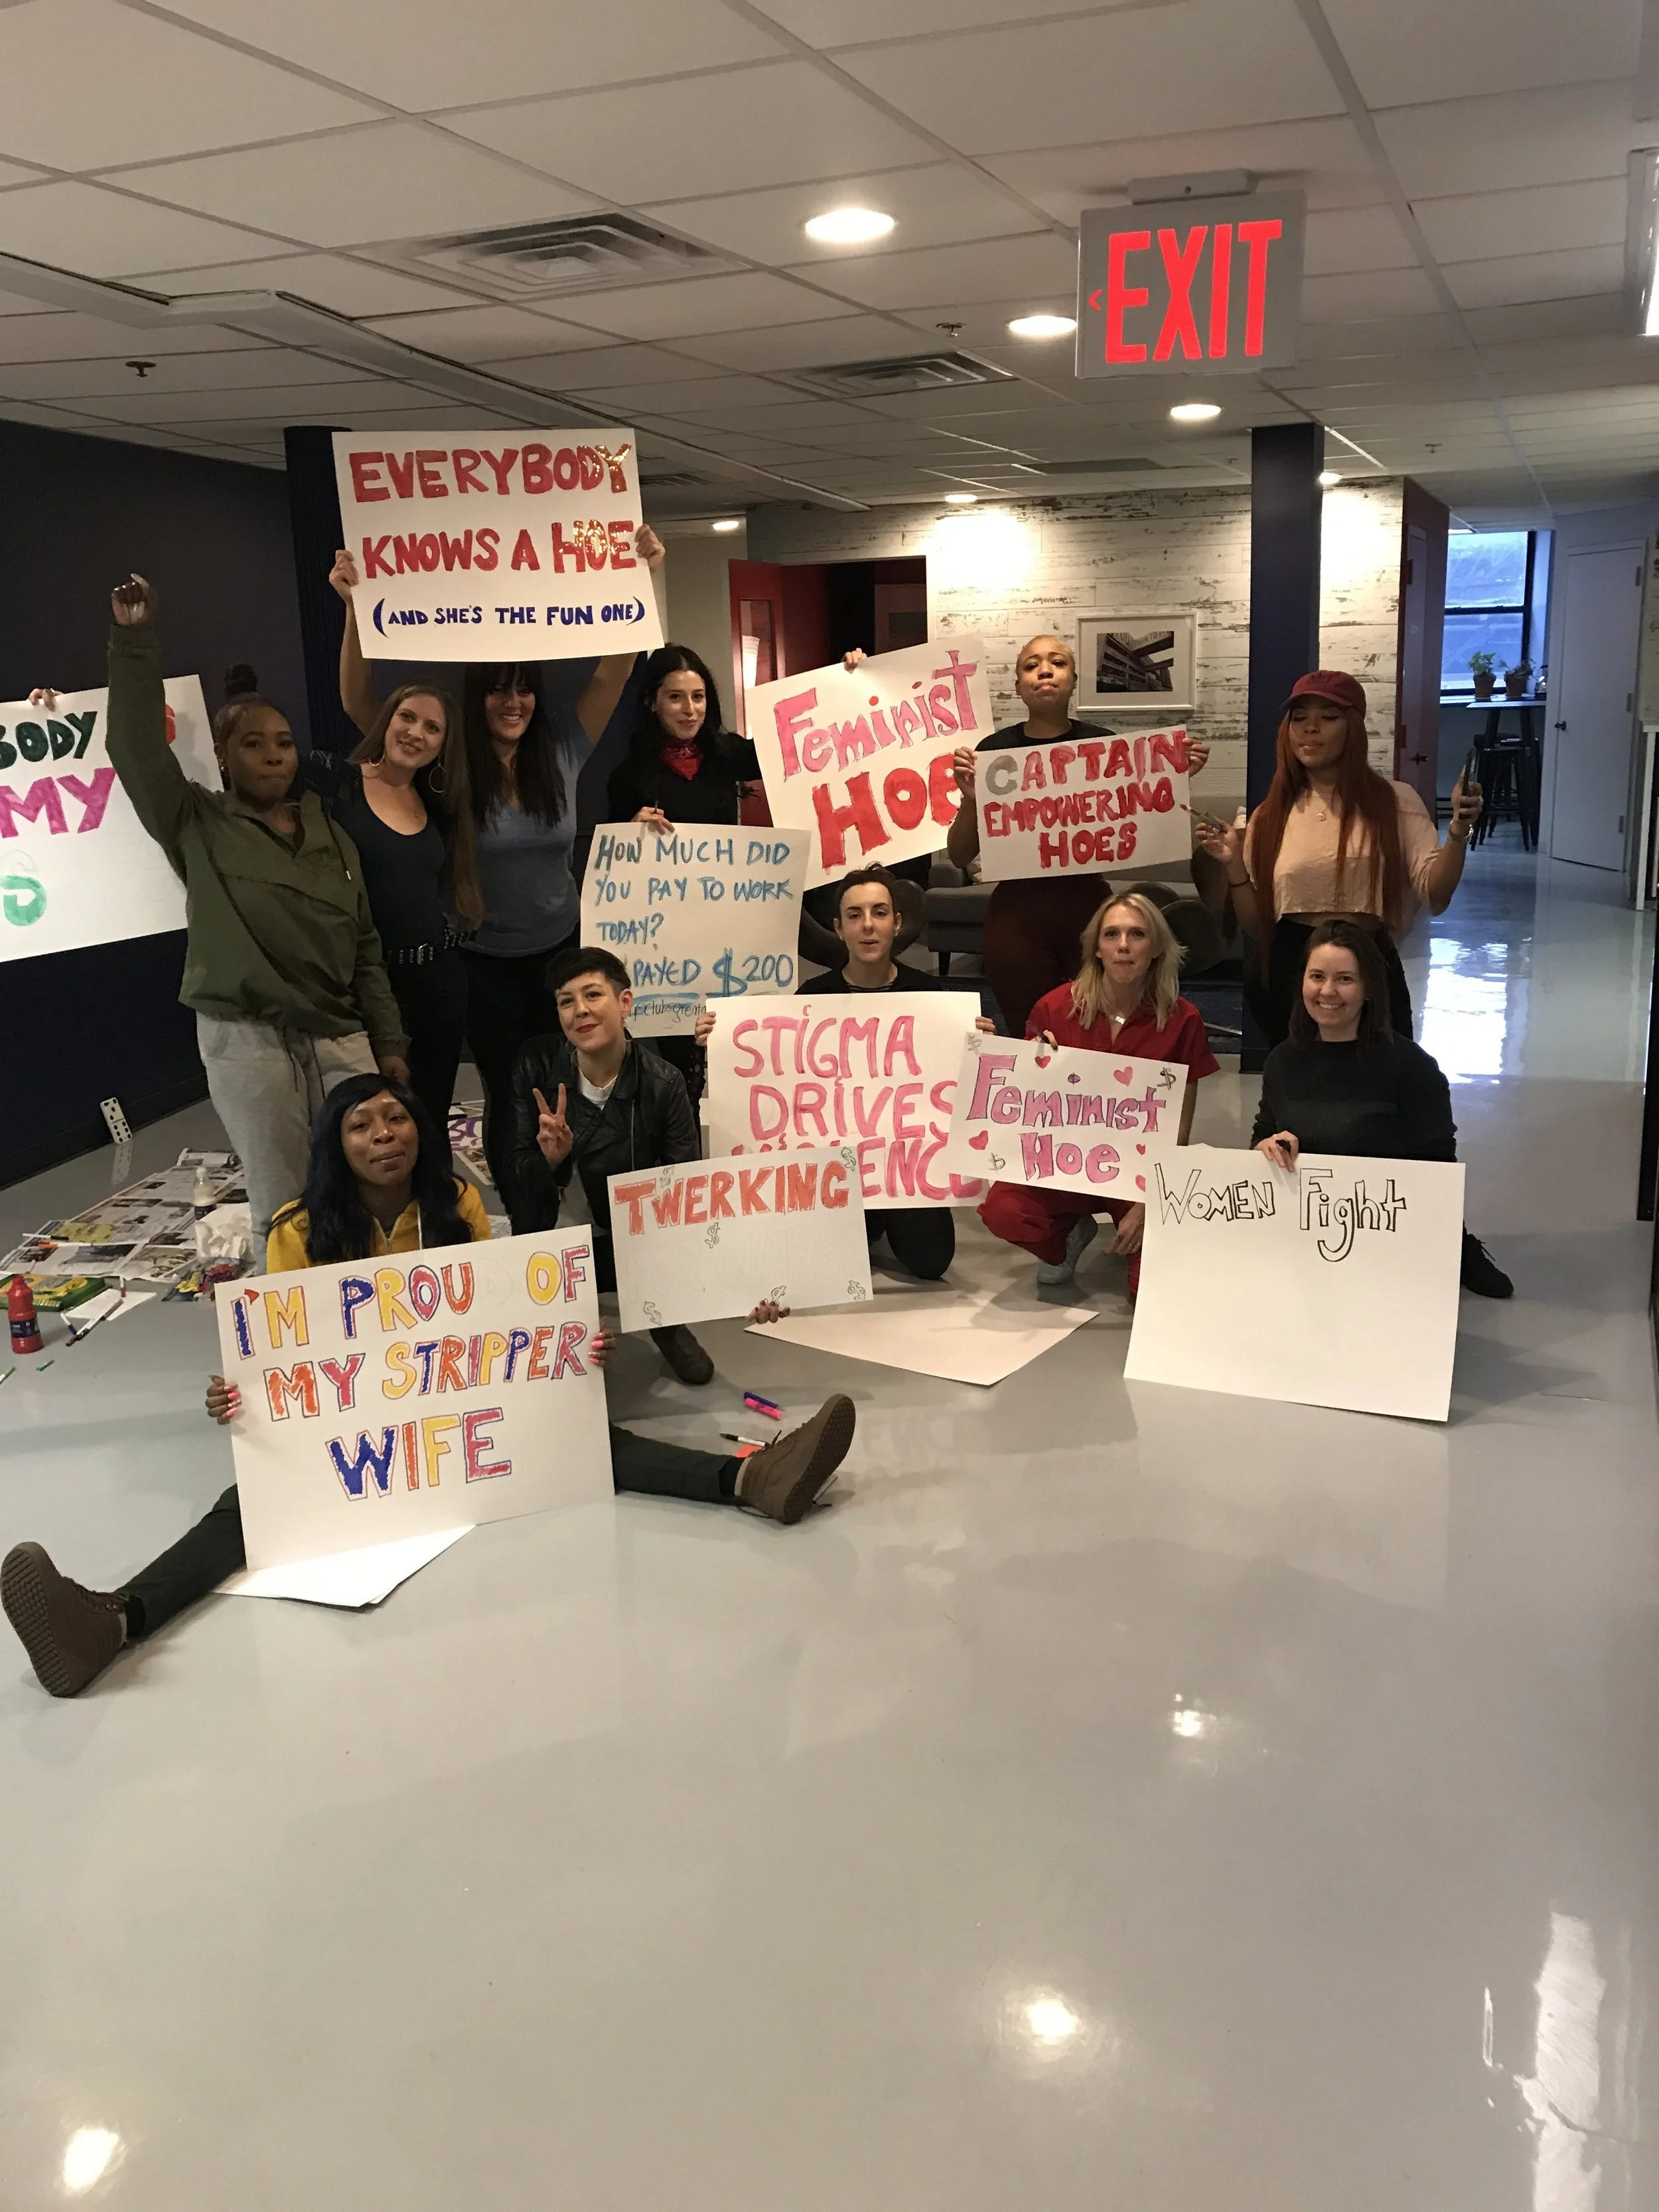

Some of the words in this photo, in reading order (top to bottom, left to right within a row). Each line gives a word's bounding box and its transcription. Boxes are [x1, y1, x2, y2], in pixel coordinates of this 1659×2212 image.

[1106, 220, 1282, 363] EXIT
[349, 443, 631, 502] EVERYBODY
[362, 528, 500, 579] KNOWS
[512, 529, 540, 571] A
[551, 519, 637, 573] HOE
[373, 598, 428, 638] (AND
[434, 605, 482, 625] SHE'S
[495, 607, 536, 625] THE
[547, 606, 593, 626] FUN
[601, 597, 645, 626] ONE)
[774, 650, 980, 783] Feminist
[985, 730, 1189, 796] CAPTAIN
[594, 834, 642, 871] HOW
[656, 834, 733, 865] MUCH
[746, 840, 790, 865] DID
[1038, 821, 1137, 869] HOES
[595, 874, 631, 906] YOU
[648, 877, 687, 905] PAY
[697, 876, 725, 901] TO
[734, 878, 794, 903] WORK
[595, 913, 664, 950] TODAY?
[633, 956, 701, 987] PAYED
[710, 947, 794, 995] $200
[966, 1053, 1167, 1133] Feminist
[614, 1160, 849, 1236] TWERKING
[1299, 1168, 1407, 1262] Fight
[230, 1286, 309, 1361] I'M
[526, 1244, 589, 1305] OF
[263, 1353, 365, 1422] MY
[382, 1321, 587, 1400] STRIPPER
[325, 1407, 512, 1501] WIFE
